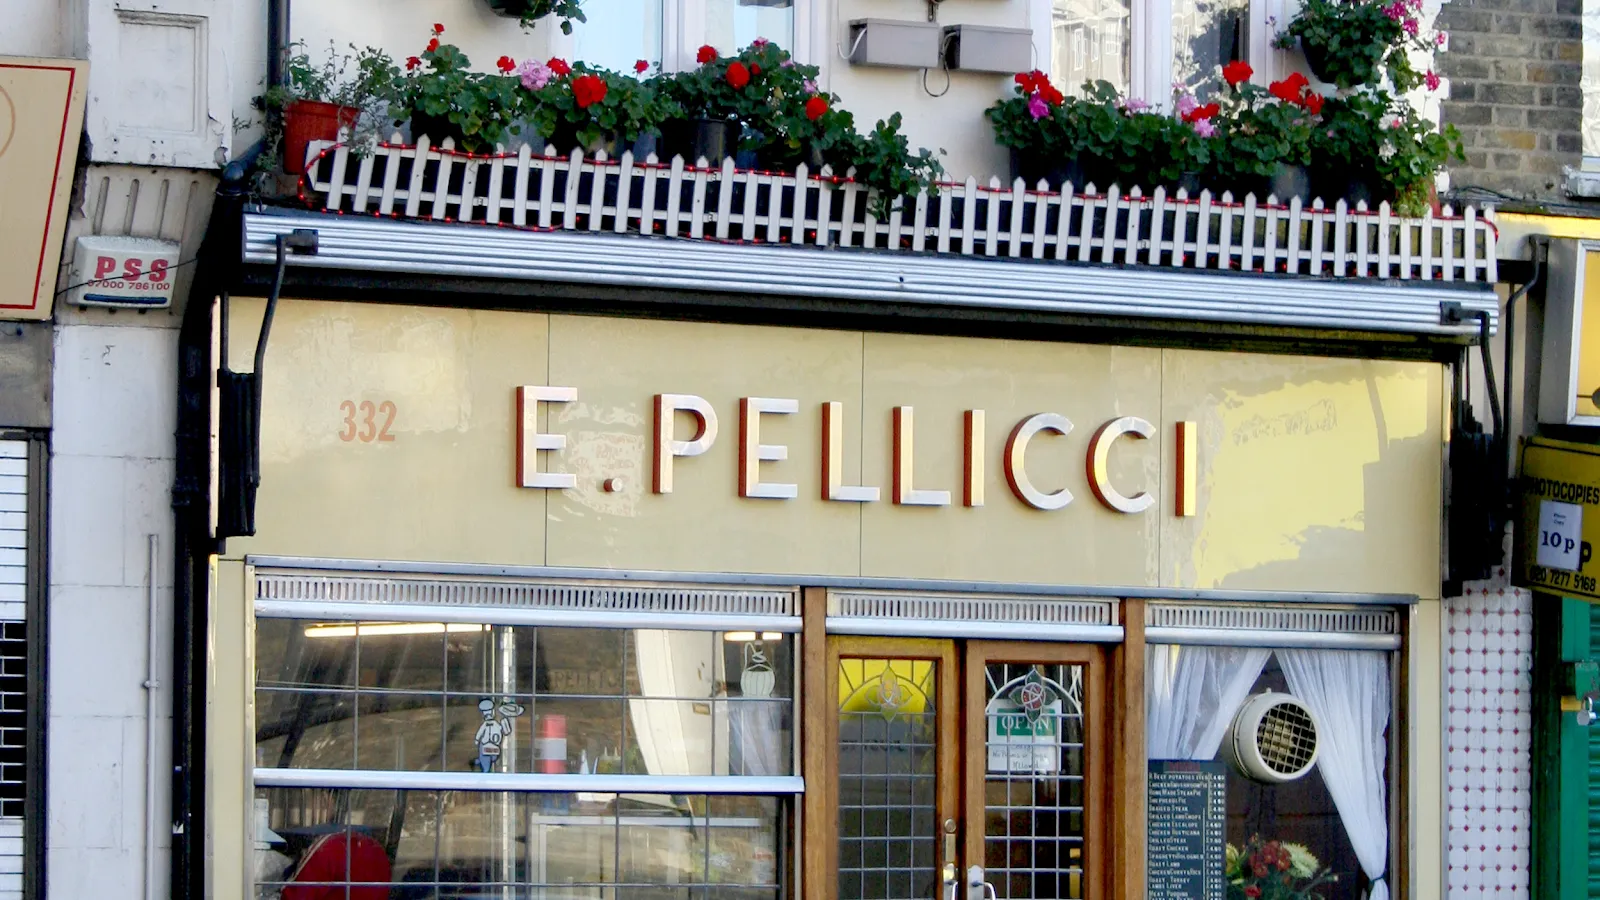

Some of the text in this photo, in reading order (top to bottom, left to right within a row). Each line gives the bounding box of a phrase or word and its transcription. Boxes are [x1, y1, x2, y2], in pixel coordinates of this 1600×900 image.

[94, 255, 169, 282] PSS
[128, 281, 170, 290] 786100
[338, 400, 397, 442] 332
[651, 393, 1197, 517] PELLICCI
[1550, 568, 1571, 587] 7277
[1574, 574, 1597, 592] 5168
